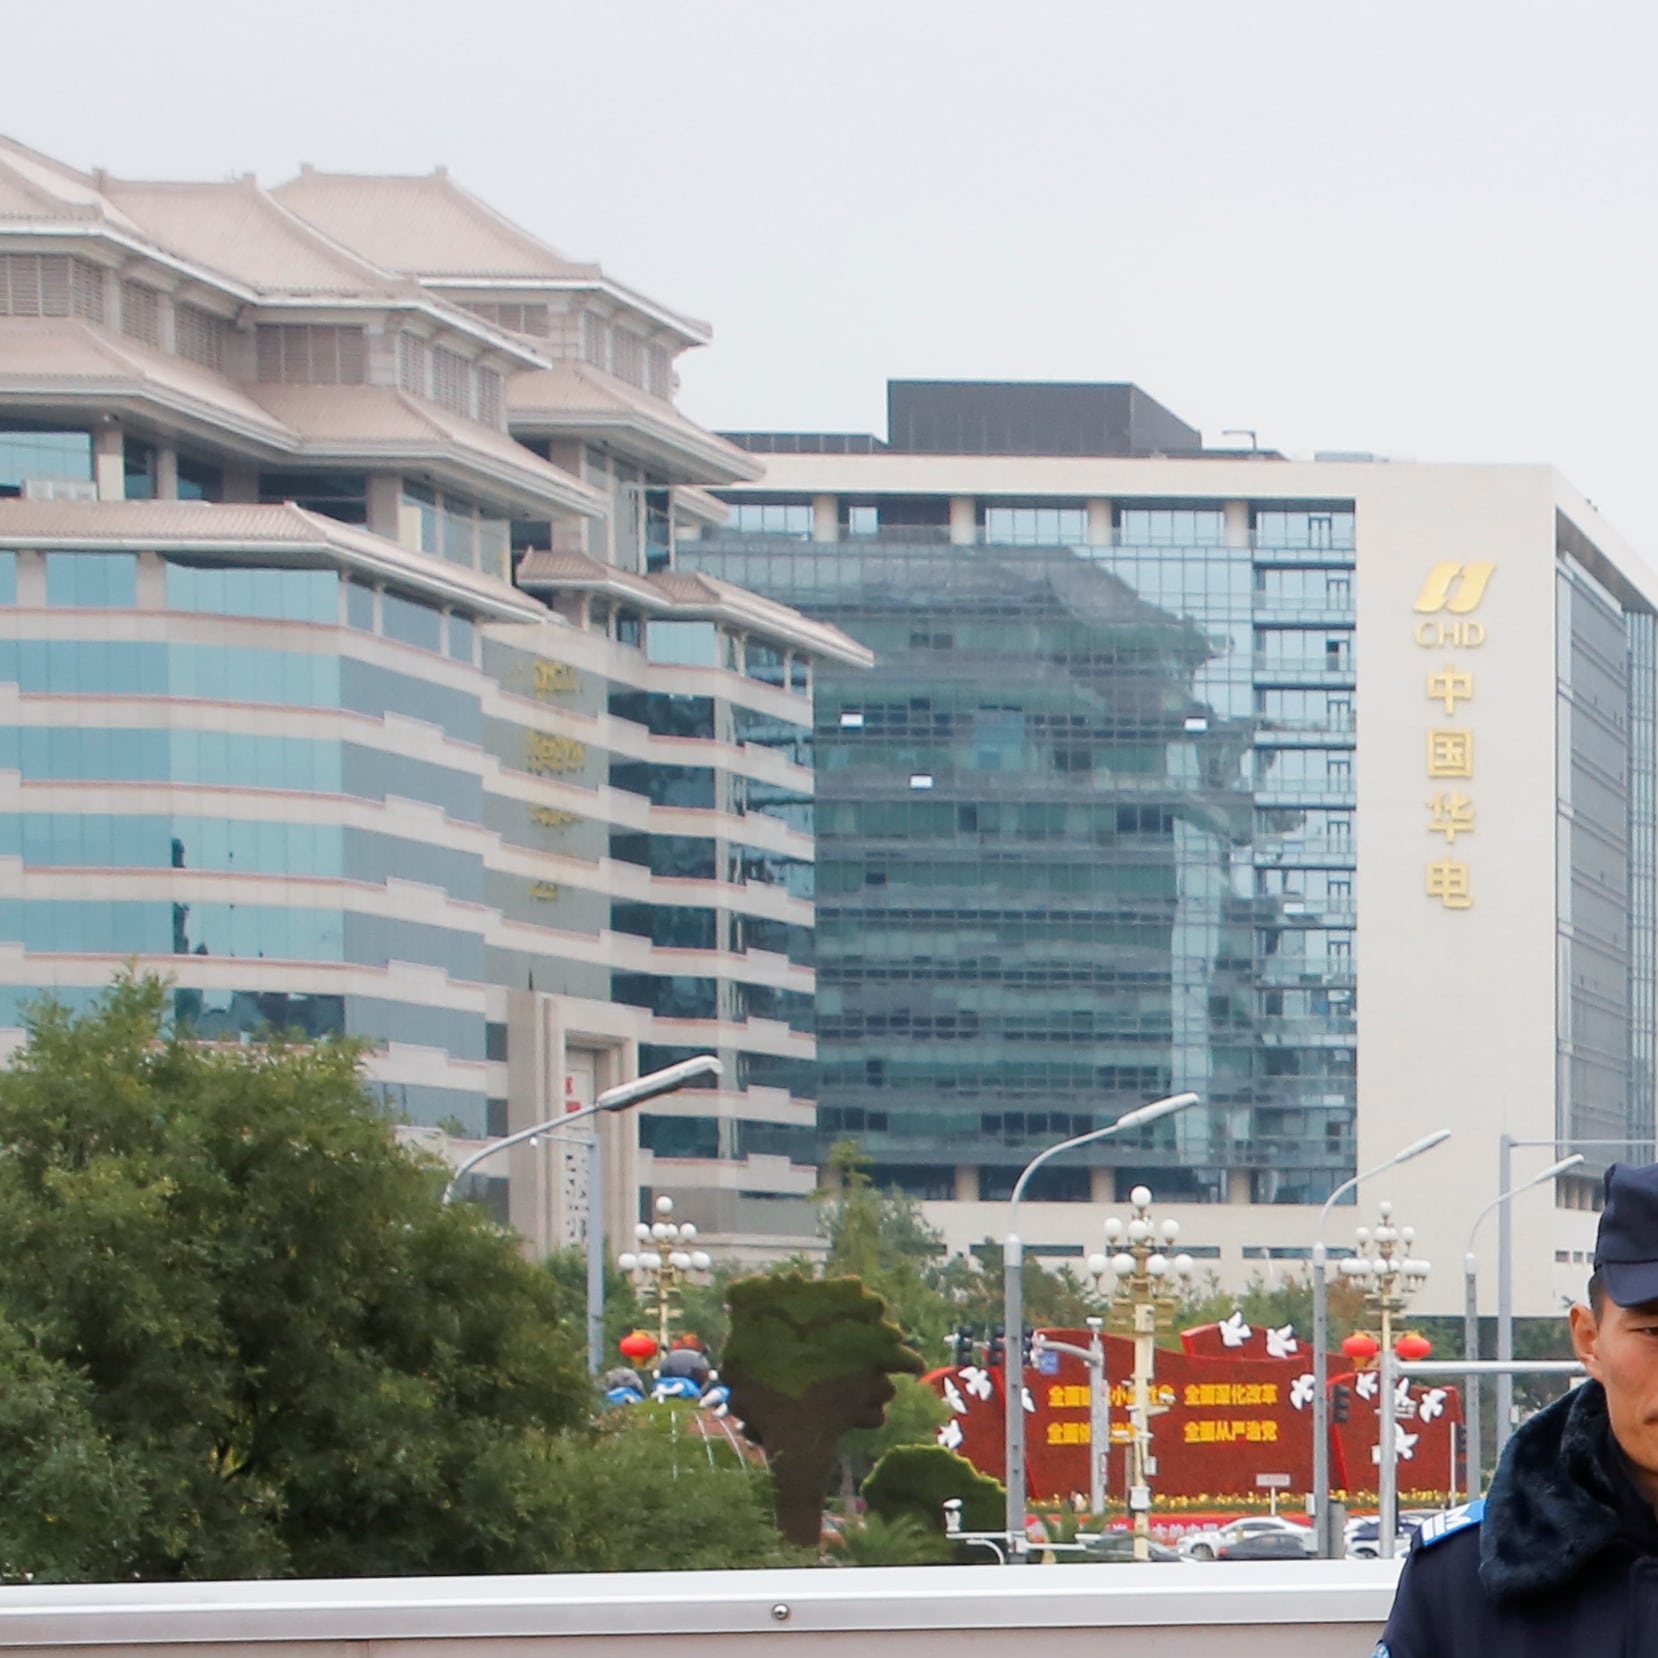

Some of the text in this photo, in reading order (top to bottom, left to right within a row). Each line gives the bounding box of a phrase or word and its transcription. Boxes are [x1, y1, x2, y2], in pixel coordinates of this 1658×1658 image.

[1414, 621, 1487, 649] CHD
[1426, 663, 1477, 910] 中国华电
